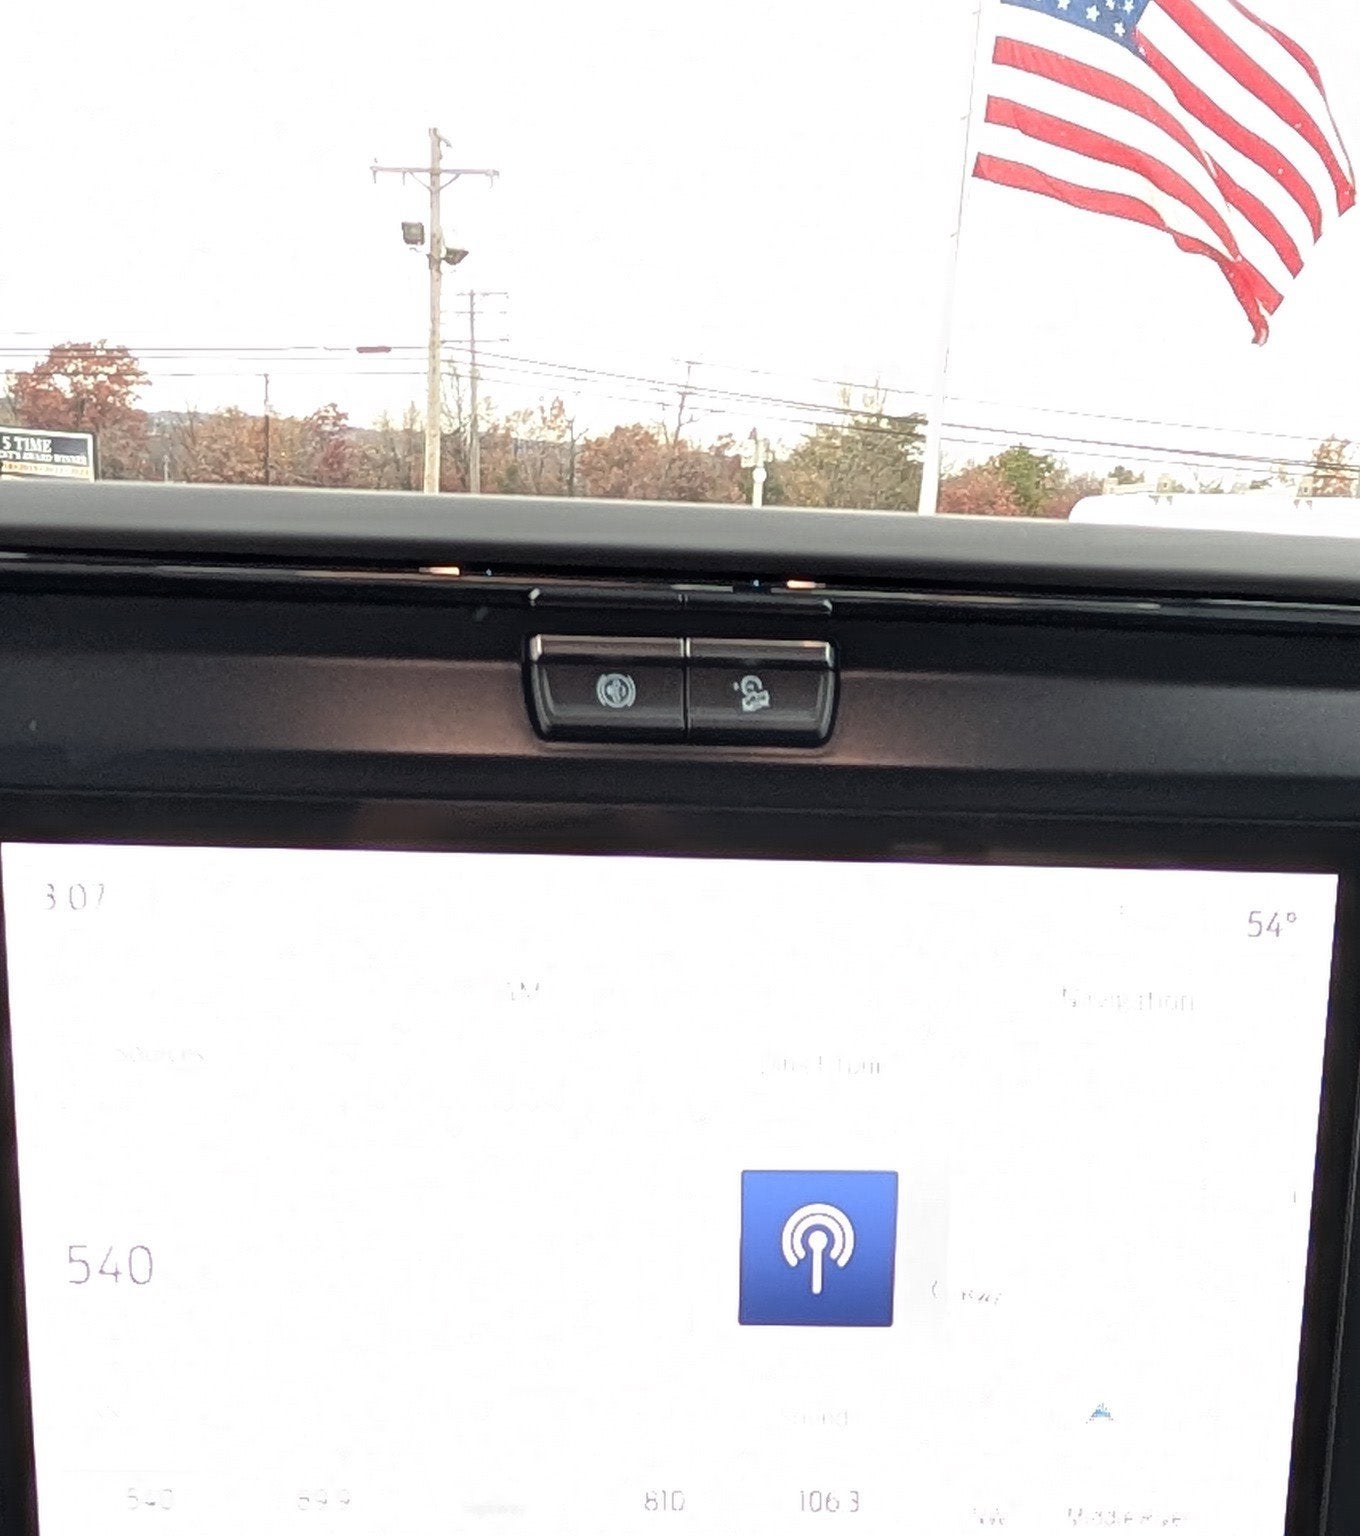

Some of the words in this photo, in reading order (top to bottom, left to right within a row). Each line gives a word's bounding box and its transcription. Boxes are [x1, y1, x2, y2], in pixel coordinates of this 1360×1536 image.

[2, 436, 11, 450] 5
[14, 437, 52, 453] TIME
[68, 1246, 153, 1285] 540
[644, 1489, 685, 1511] 810
